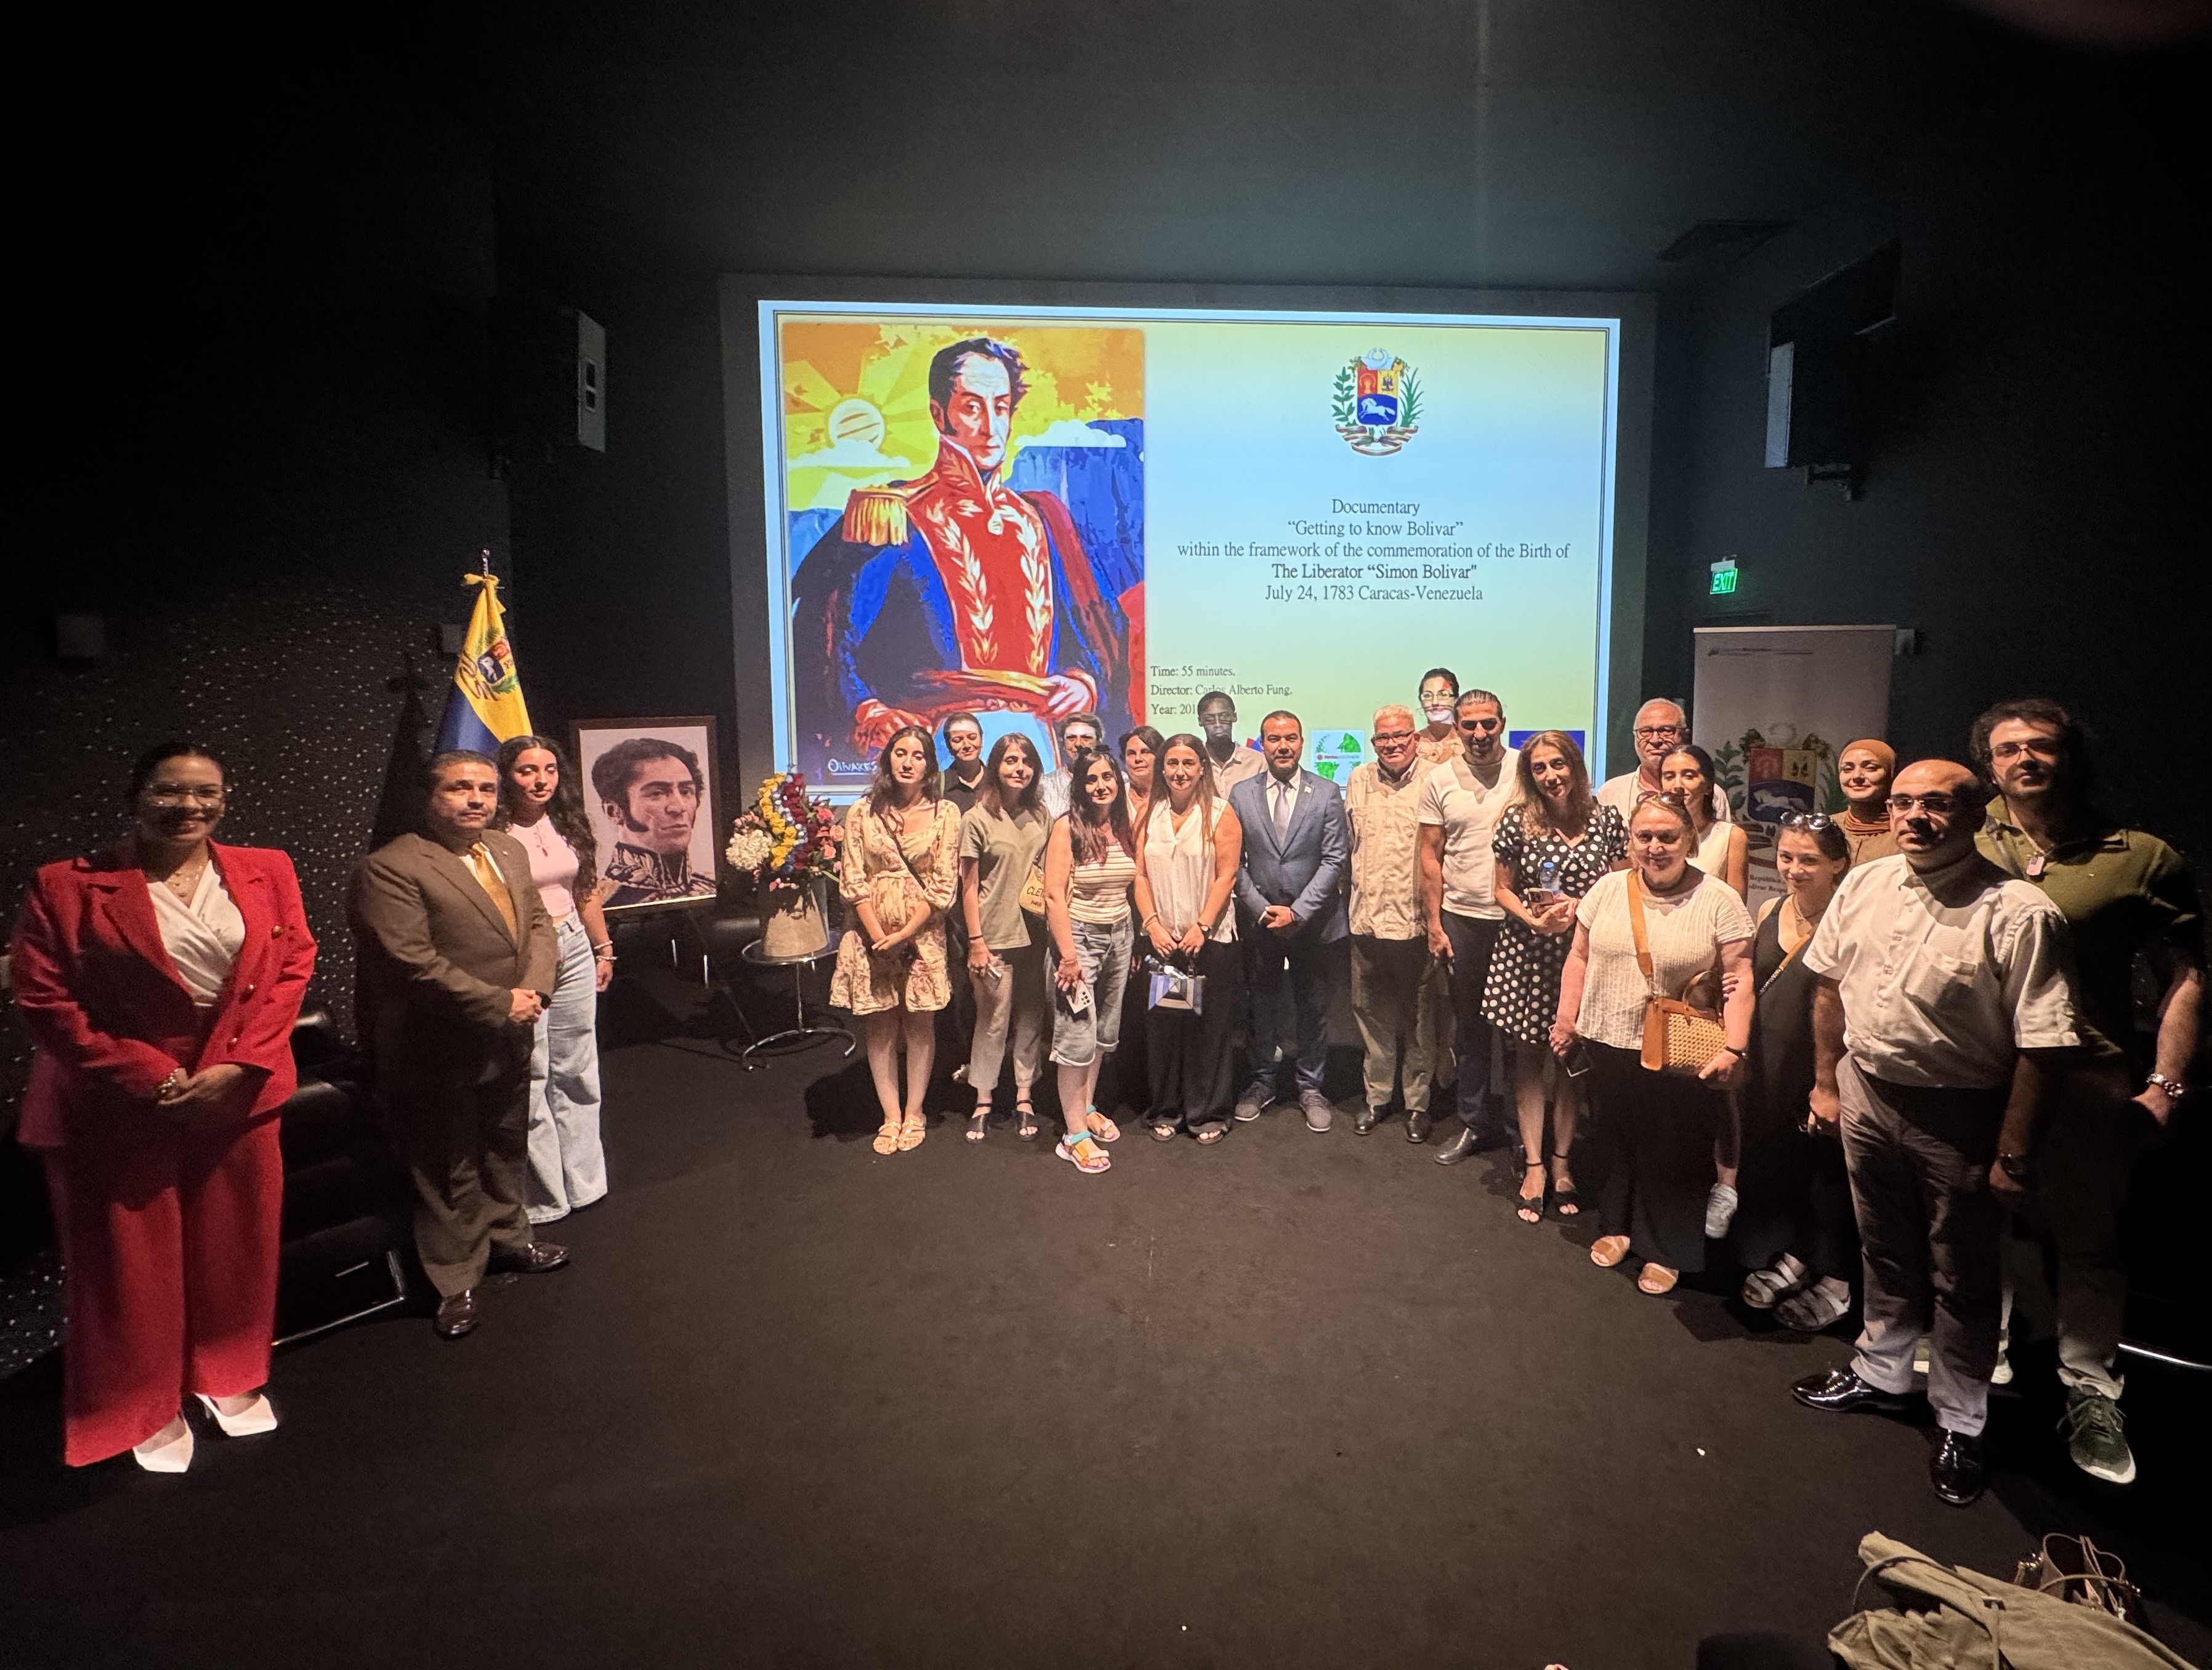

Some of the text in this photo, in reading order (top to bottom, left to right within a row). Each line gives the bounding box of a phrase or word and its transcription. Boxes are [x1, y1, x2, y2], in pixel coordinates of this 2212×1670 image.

[1332, 499, 1420, 516] Documentary
[1288, 520, 1464, 538] “Getting to know Bolivar”
[1177, 541, 1572, 558] within the framework of the commemoration of the Birth of
[1272, 563, 1477, 579] The Liberator “Simon Bolivar"
[1712, 571, 1735, 591] EXIT
[1265, 585, 1483, 602] July 24, 1783 Caracas-Venezuela
[1150, 665, 1236, 677] Time: 55 minutes.
[1151, 684, 1193, 696] Director:
[1229, 684, 1264, 696] Alberto
[1267, 684, 1293, 697] Fung.
[1151, 704, 1196, 715] Year: 201
